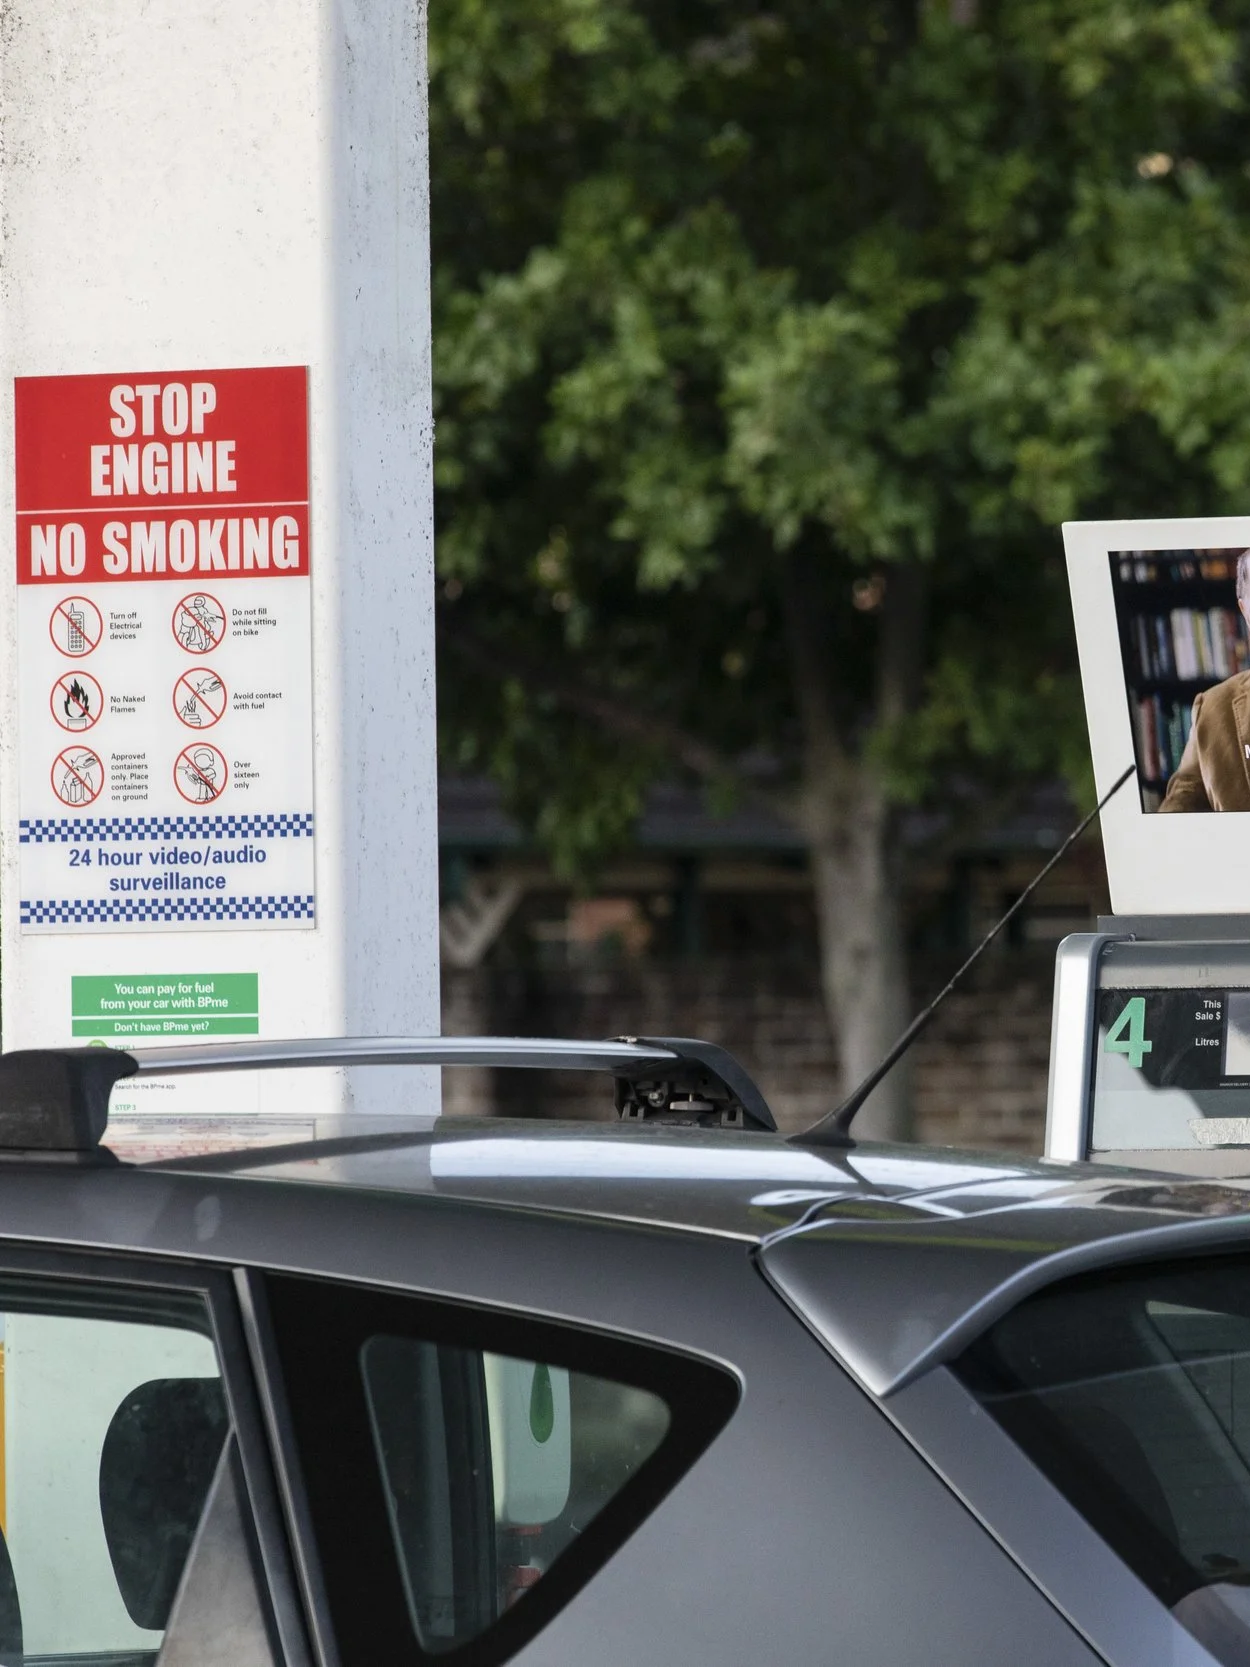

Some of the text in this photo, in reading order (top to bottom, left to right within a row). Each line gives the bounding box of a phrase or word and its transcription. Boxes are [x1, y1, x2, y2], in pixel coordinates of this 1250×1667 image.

[109, 382, 217, 438] STOP
[90, 440, 238, 497] ENGINE
[30, 515, 300, 577] NO SMOKING
[109, 612, 126, 620] Turn
[232, 608, 241, 616] Do
[109, 622, 142, 630] Electrical
[254, 618, 277, 627] sitting
[109, 632, 137, 640] devices
[122, 695, 146, 703] Naked
[233, 692, 282, 700] Avoid contact
[251, 702, 265, 710] fuel
[111, 753, 146, 761] Approved
[233, 771, 260, 779] sixteen
[111, 783, 149, 791] containers
[233, 782, 250, 790] only
[122, 793, 148, 802] ground
[69, 844, 267, 867] 24 hour video/audio
[109, 872, 227, 892] surveillance
[114, 981, 214, 997] You can pay for fuel
[100, 996, 229, 1011] from your car with BPme
[1203, 1000, 1222, 1009] This
[1195, 1011, 1221, 1020] Sale $
[114, 1021, 210, 1033] Don't have BPme yet?
[1104, 997, 1152, 1068] 4
[1195, 1037, 1220, 1046] Litres
